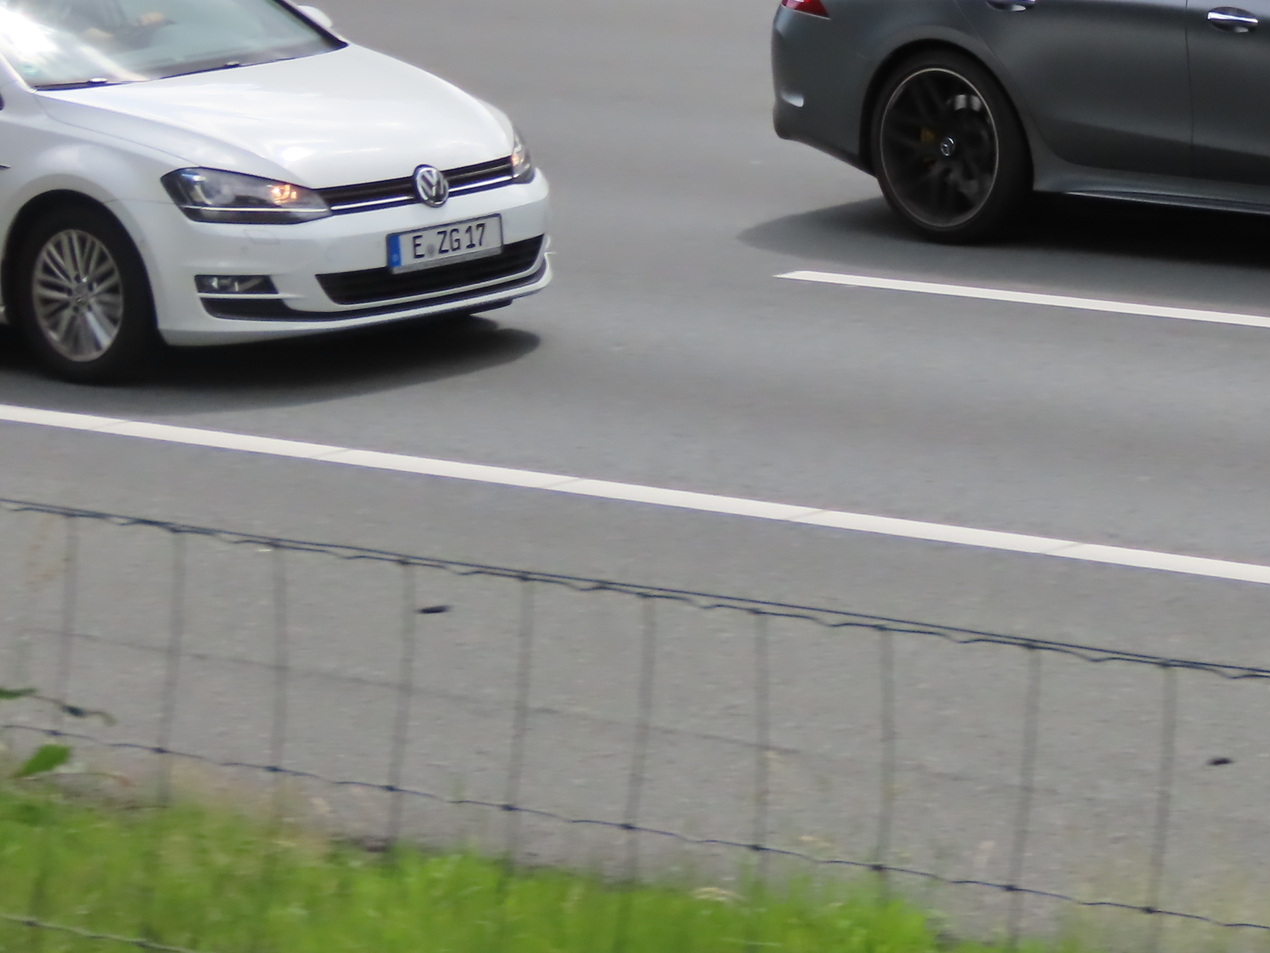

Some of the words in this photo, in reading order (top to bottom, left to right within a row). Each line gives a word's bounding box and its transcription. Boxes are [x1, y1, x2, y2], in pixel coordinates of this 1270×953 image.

[412, 235, 425, 259] E
[437, 228, 461, 254] ZG
[465, 223, 485, 249] 17
